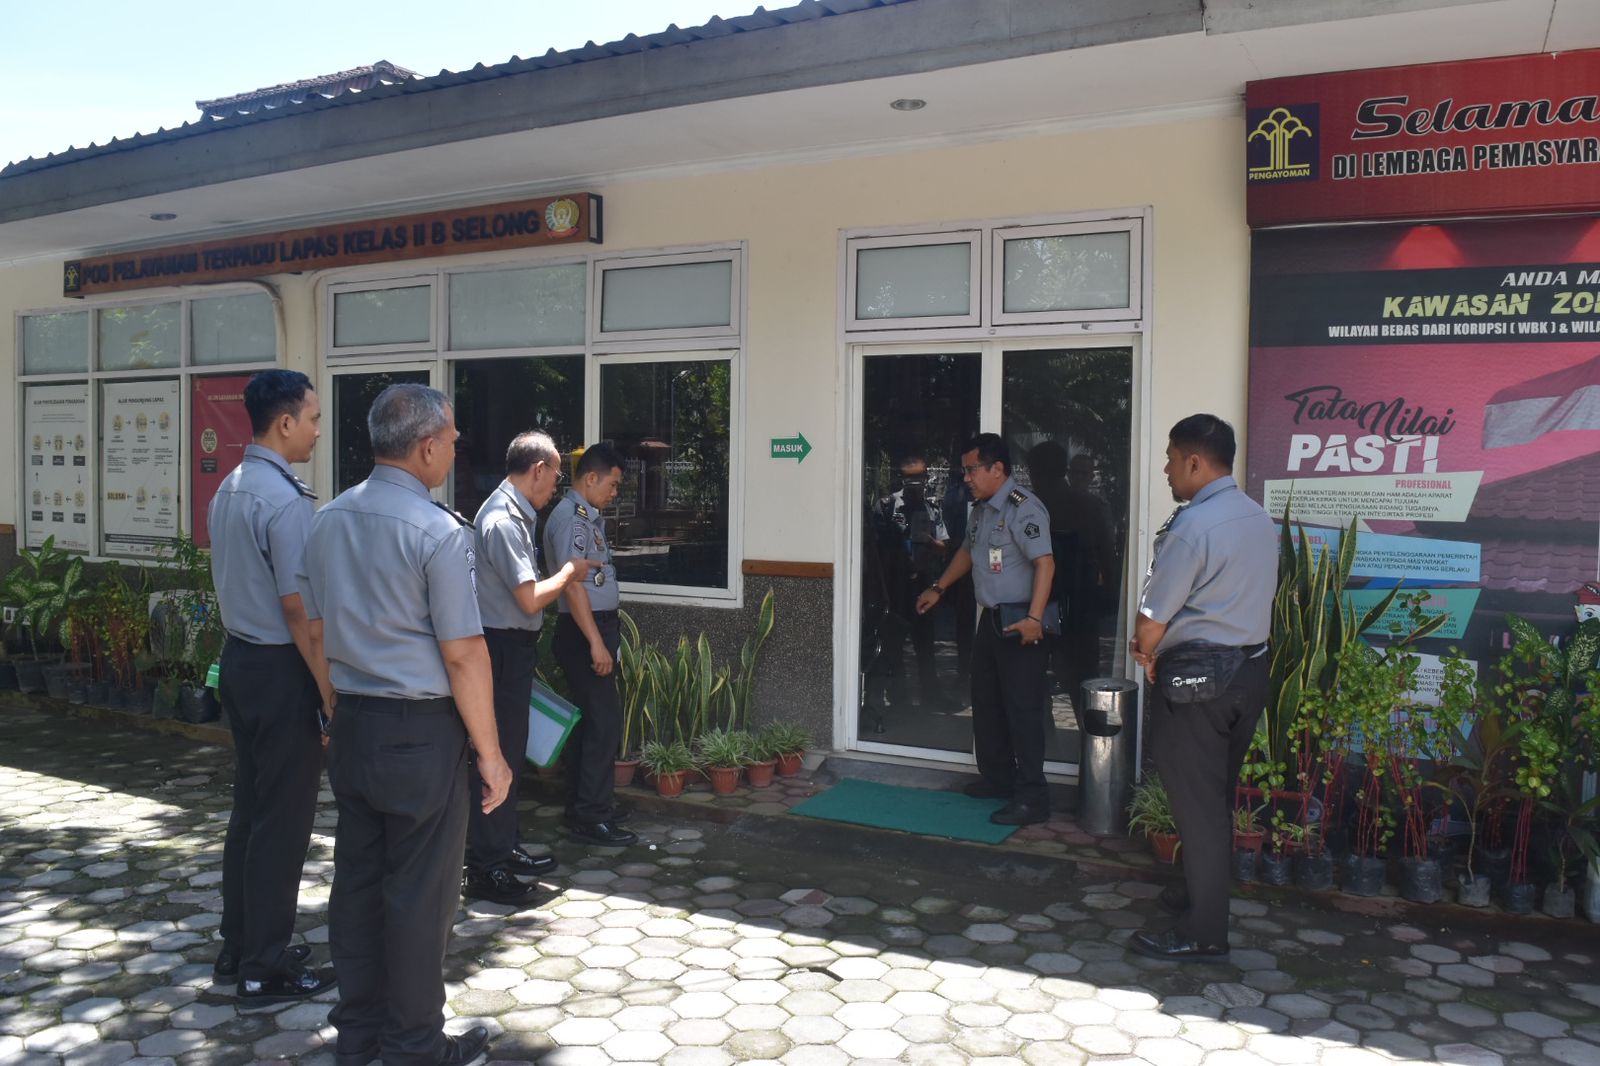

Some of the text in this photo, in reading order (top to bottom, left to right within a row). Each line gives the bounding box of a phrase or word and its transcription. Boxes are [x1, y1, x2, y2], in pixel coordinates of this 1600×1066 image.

[1332, 136, 1600, 180] DI LEMBAGA PEMASYAR
[1248, 169, 1310, 180] PENGAYOMAN
[202, 242, 276, 271] TERPADU
[279, 234, 338, 263] LAPAS
[343, 223, 407, 255] KELAS
[432, 220, 447, 245] B
[451, 209, 541, 243] SELONG
[1500, 269, 1600, 287] ANDA M
[1382, 291, 1600, 318] KAWASAN ZO
[1328, 325, 1378, 338] WILAYAH
[1381, 324, 1419, 337] BEBAS
[1422, 323, 1450, 336] DARI
[1453, 322, 1507, 336] KORUPSI
[1518, 321, 1548, 334] WBK
[1559, 322, 1569, 334] &
[1284, 385, 1456, 442] Tata Nilai
[773, 444, 803, 453] MASUK
[1287, 434, 1440, 473] PASTI
[1395, 479, 1452, 490] PROFESIONAL
